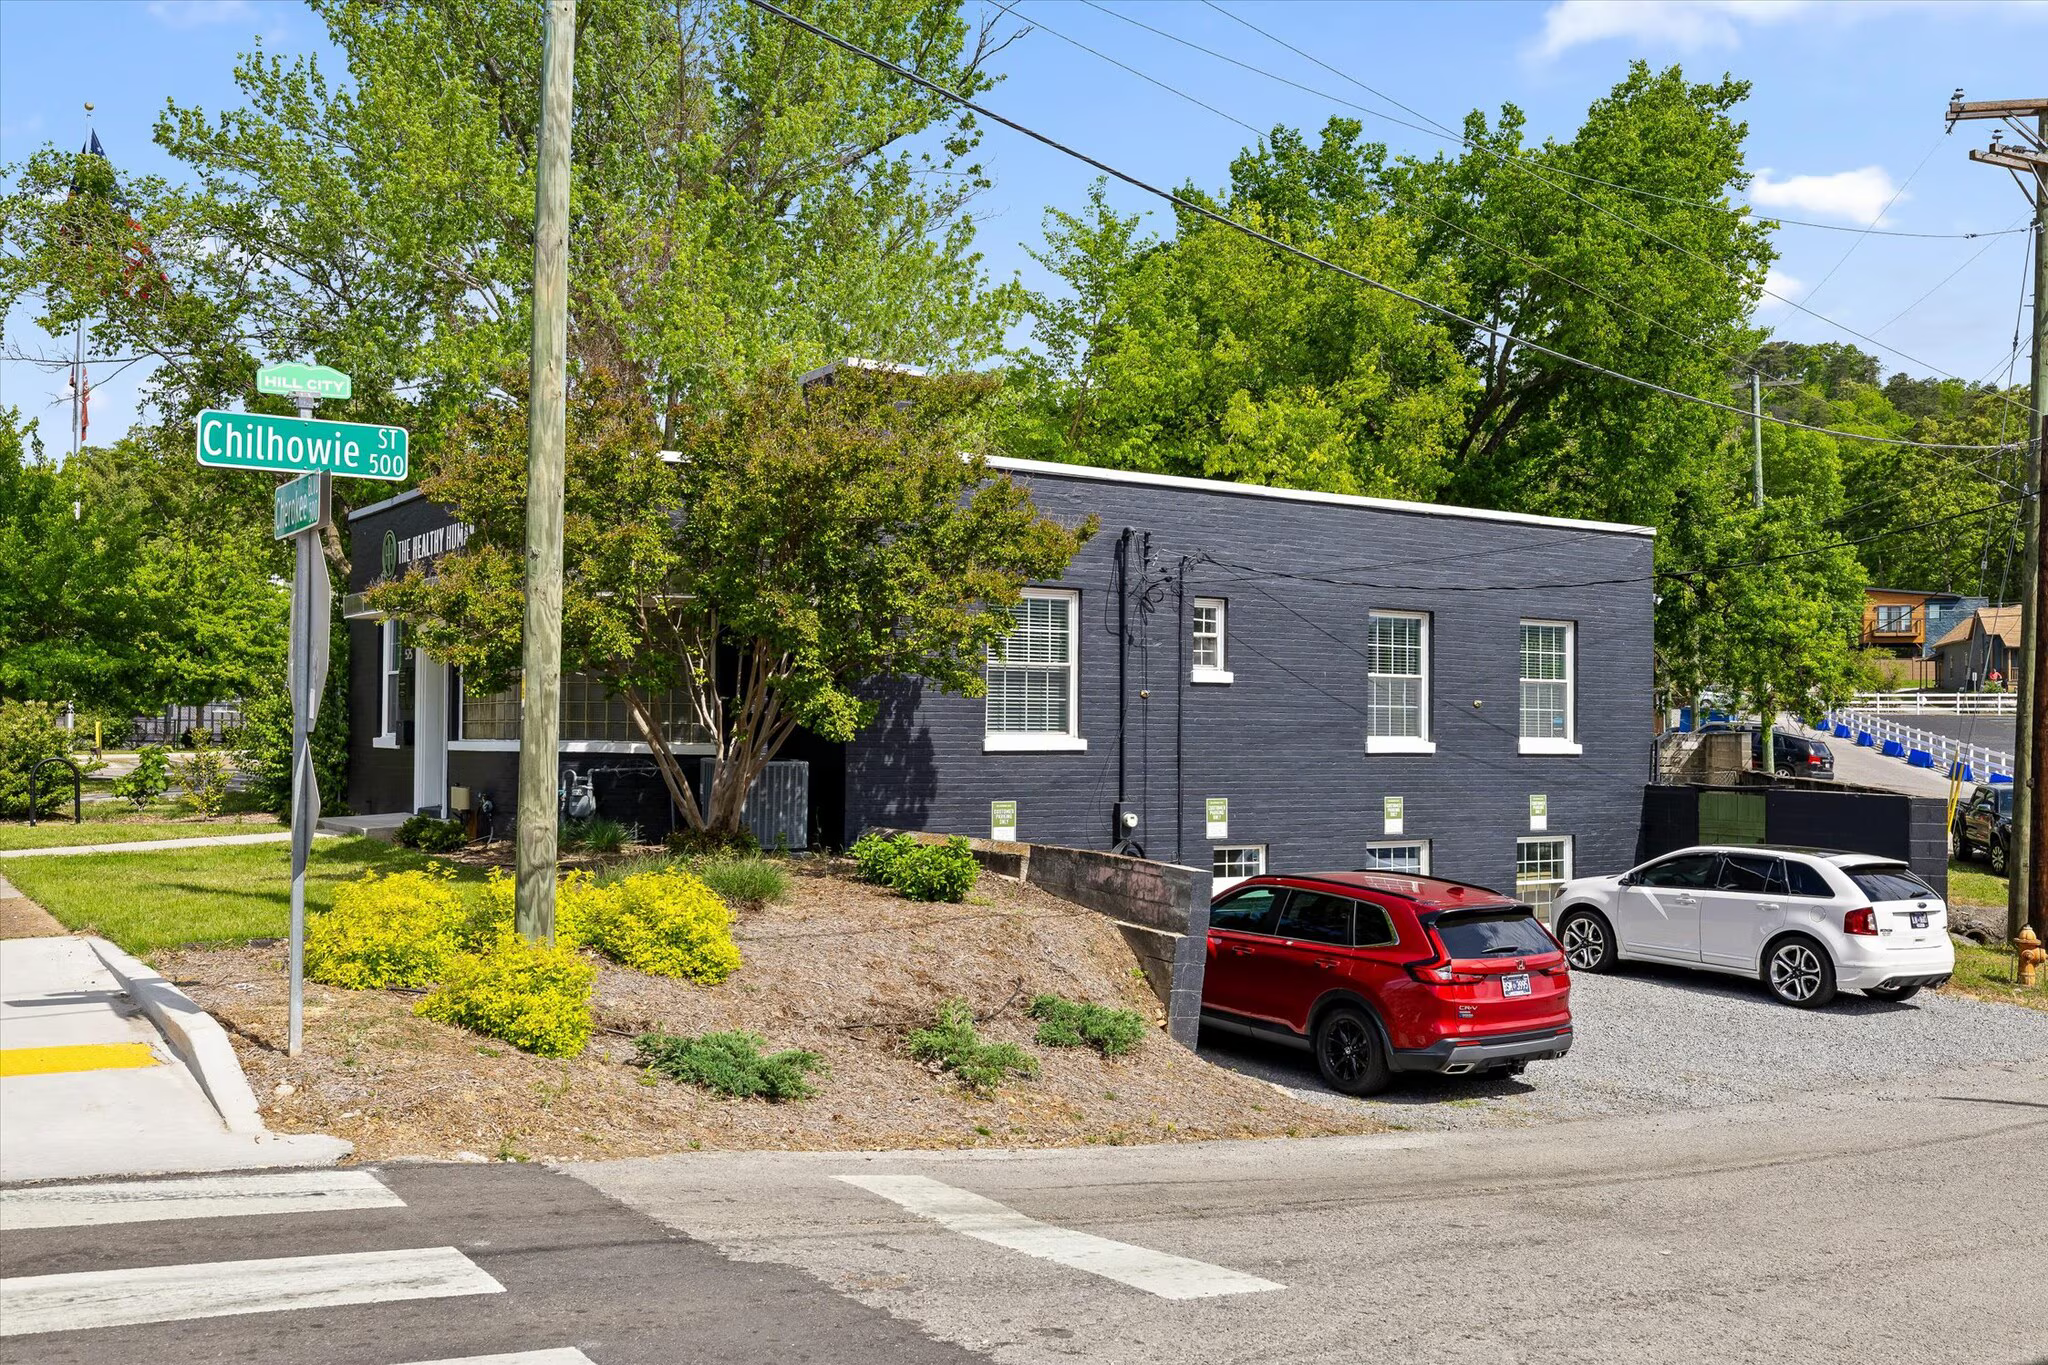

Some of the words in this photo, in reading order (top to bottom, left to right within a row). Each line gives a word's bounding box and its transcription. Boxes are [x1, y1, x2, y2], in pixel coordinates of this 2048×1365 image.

[264, 375, 303, 390] HILL
[307, 378, 346, 392] CITY
[203, 419, 360, 468] Chilhowie
[377, 428, 400, 450] ST
[369, 453, 405, 476] 500
[276, 490, 308, 530] Cherokee
[398, 538, 411, 565] THE
[412, 527, 445, 561] HEALTHY
